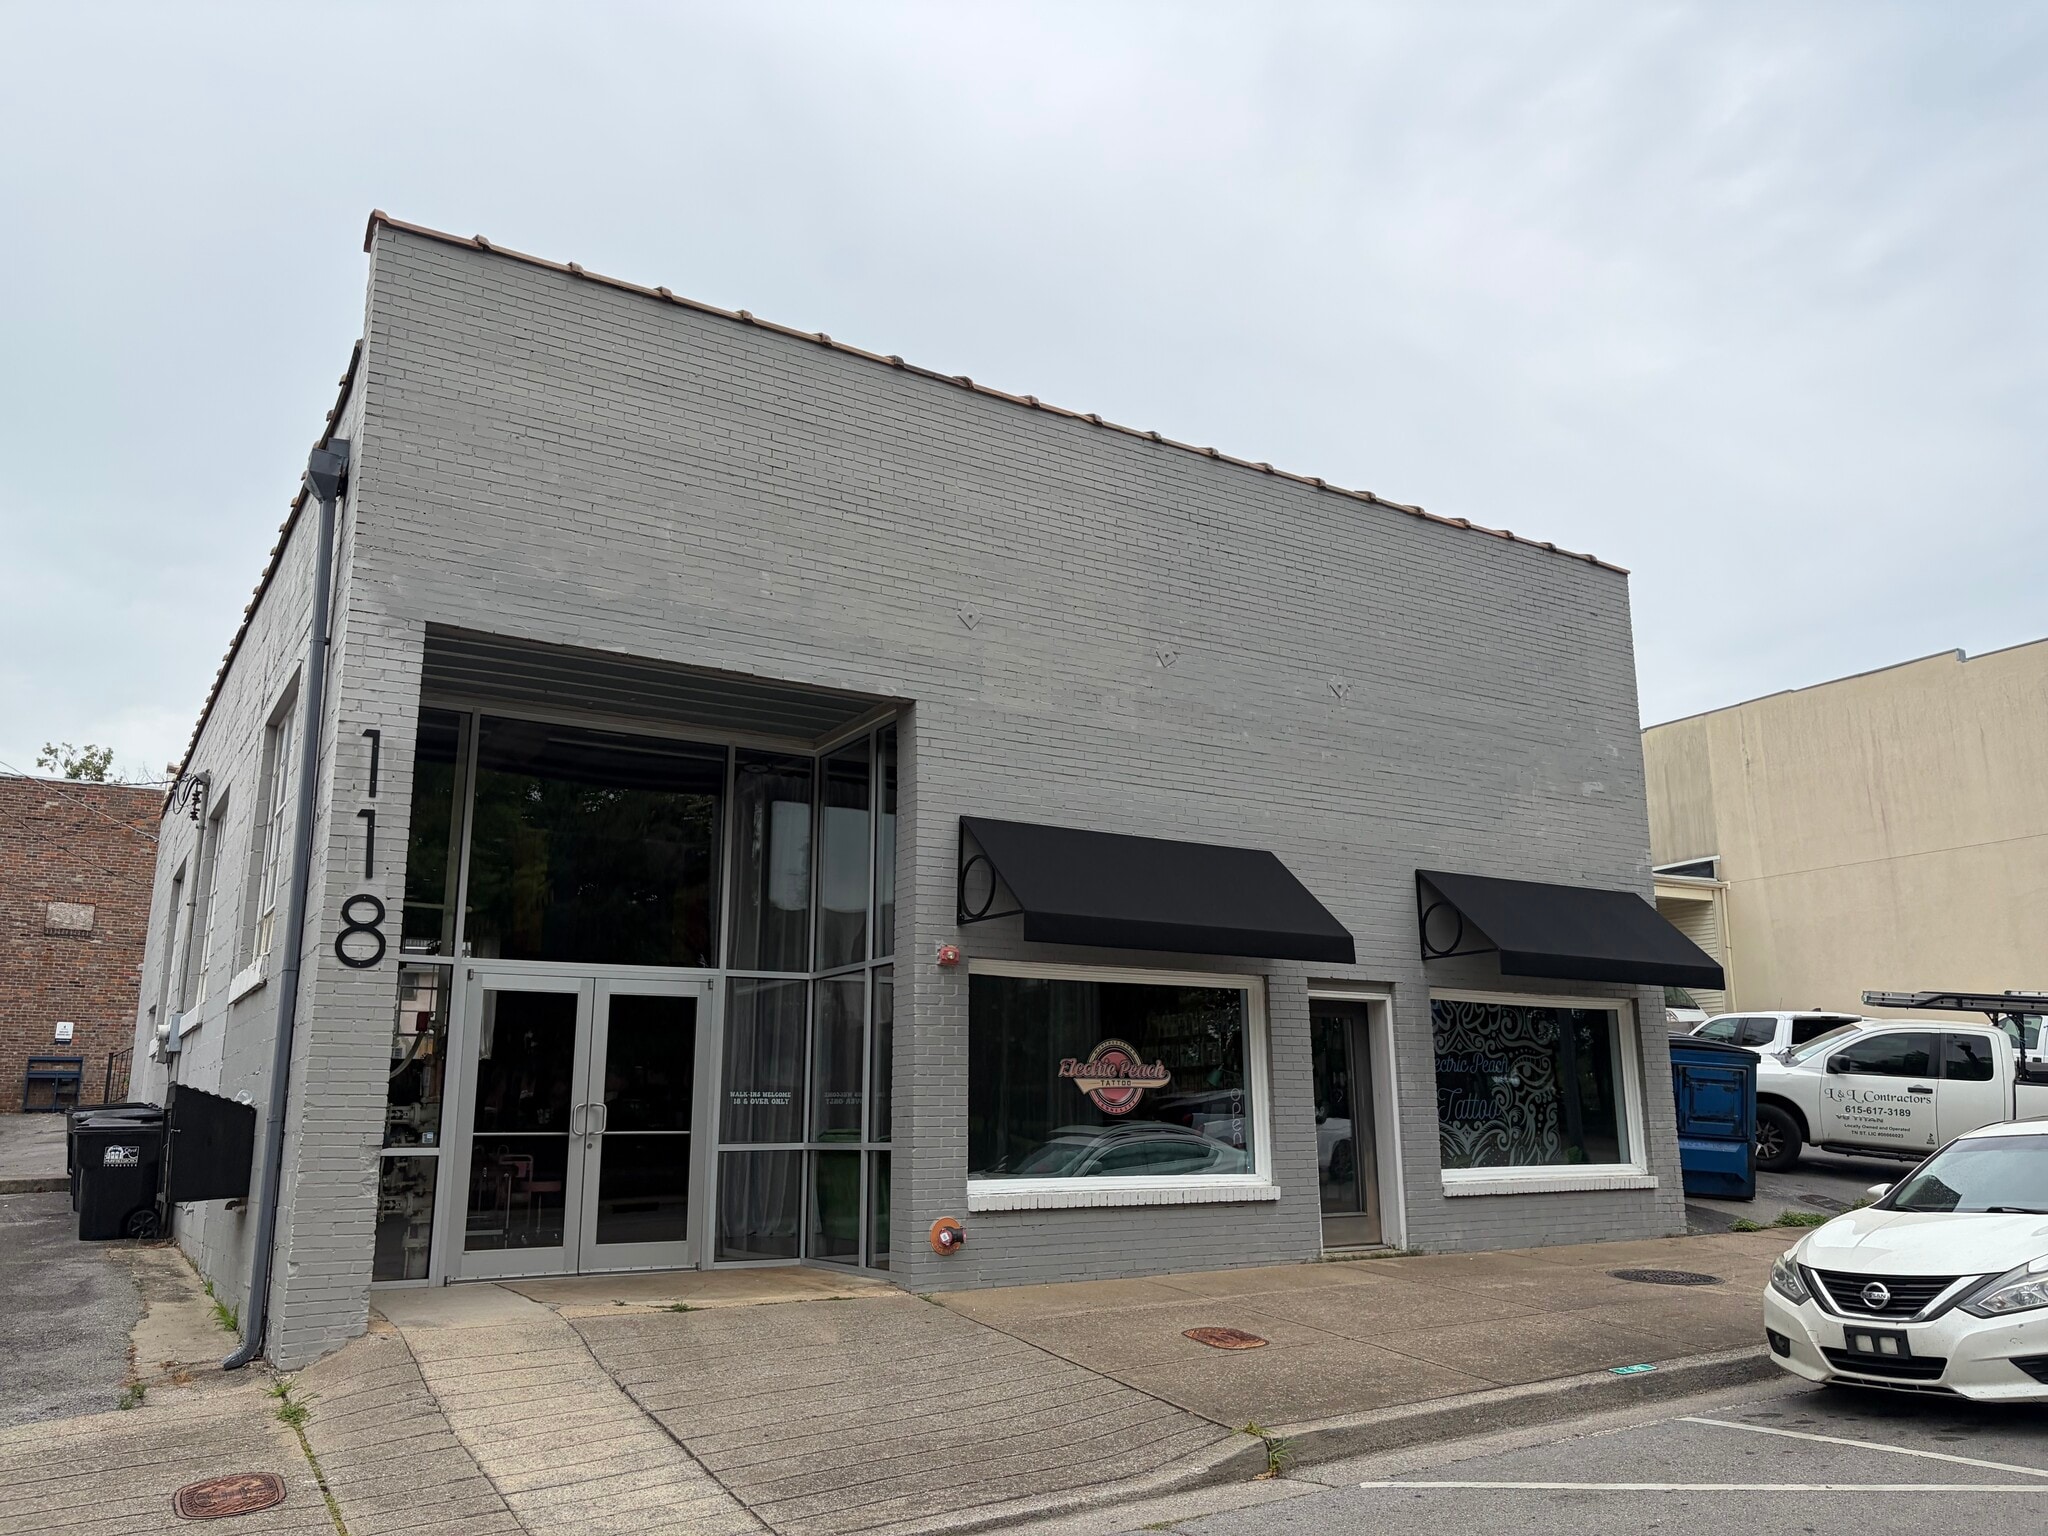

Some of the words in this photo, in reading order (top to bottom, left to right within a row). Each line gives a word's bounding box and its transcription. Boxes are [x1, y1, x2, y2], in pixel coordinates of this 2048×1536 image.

[1058, 1058, 1117, 1078] Electric
[1118, 1060, 1165, 1079] Peach
[1470, 1052, 1510, 1073] Peach
[1438, 1087, 1501, 1122] Tattoo
[1863, 1091, 1932, 1104] Contractors
[1845, 1105, 1911, 1117] 615-617-3189
